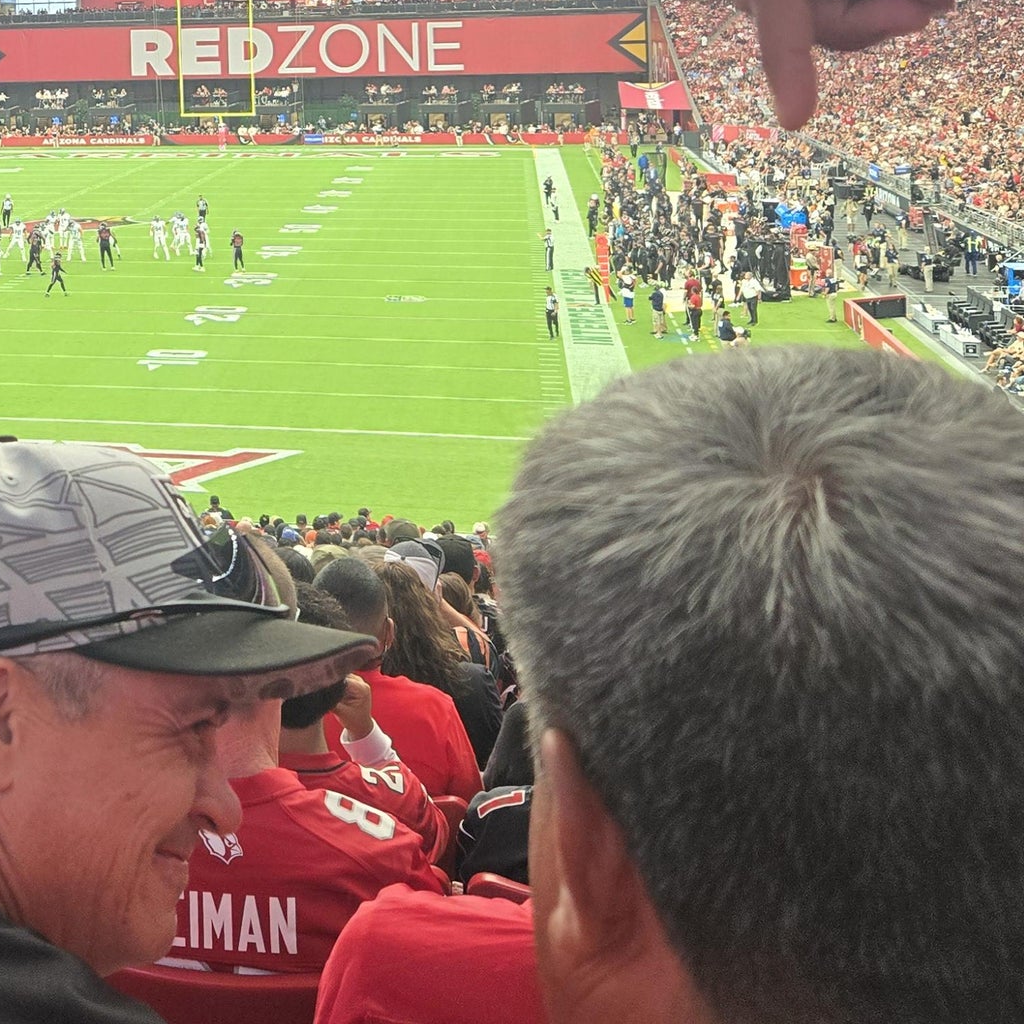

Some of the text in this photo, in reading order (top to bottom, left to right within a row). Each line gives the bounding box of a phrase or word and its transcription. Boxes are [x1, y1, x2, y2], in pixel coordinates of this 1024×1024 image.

[183, 305, 249, 323] 20
[565, 298, 615, 346] INTERCET
[136, 349, 209, 367] 10
[323, 790, 397, 841] 8
